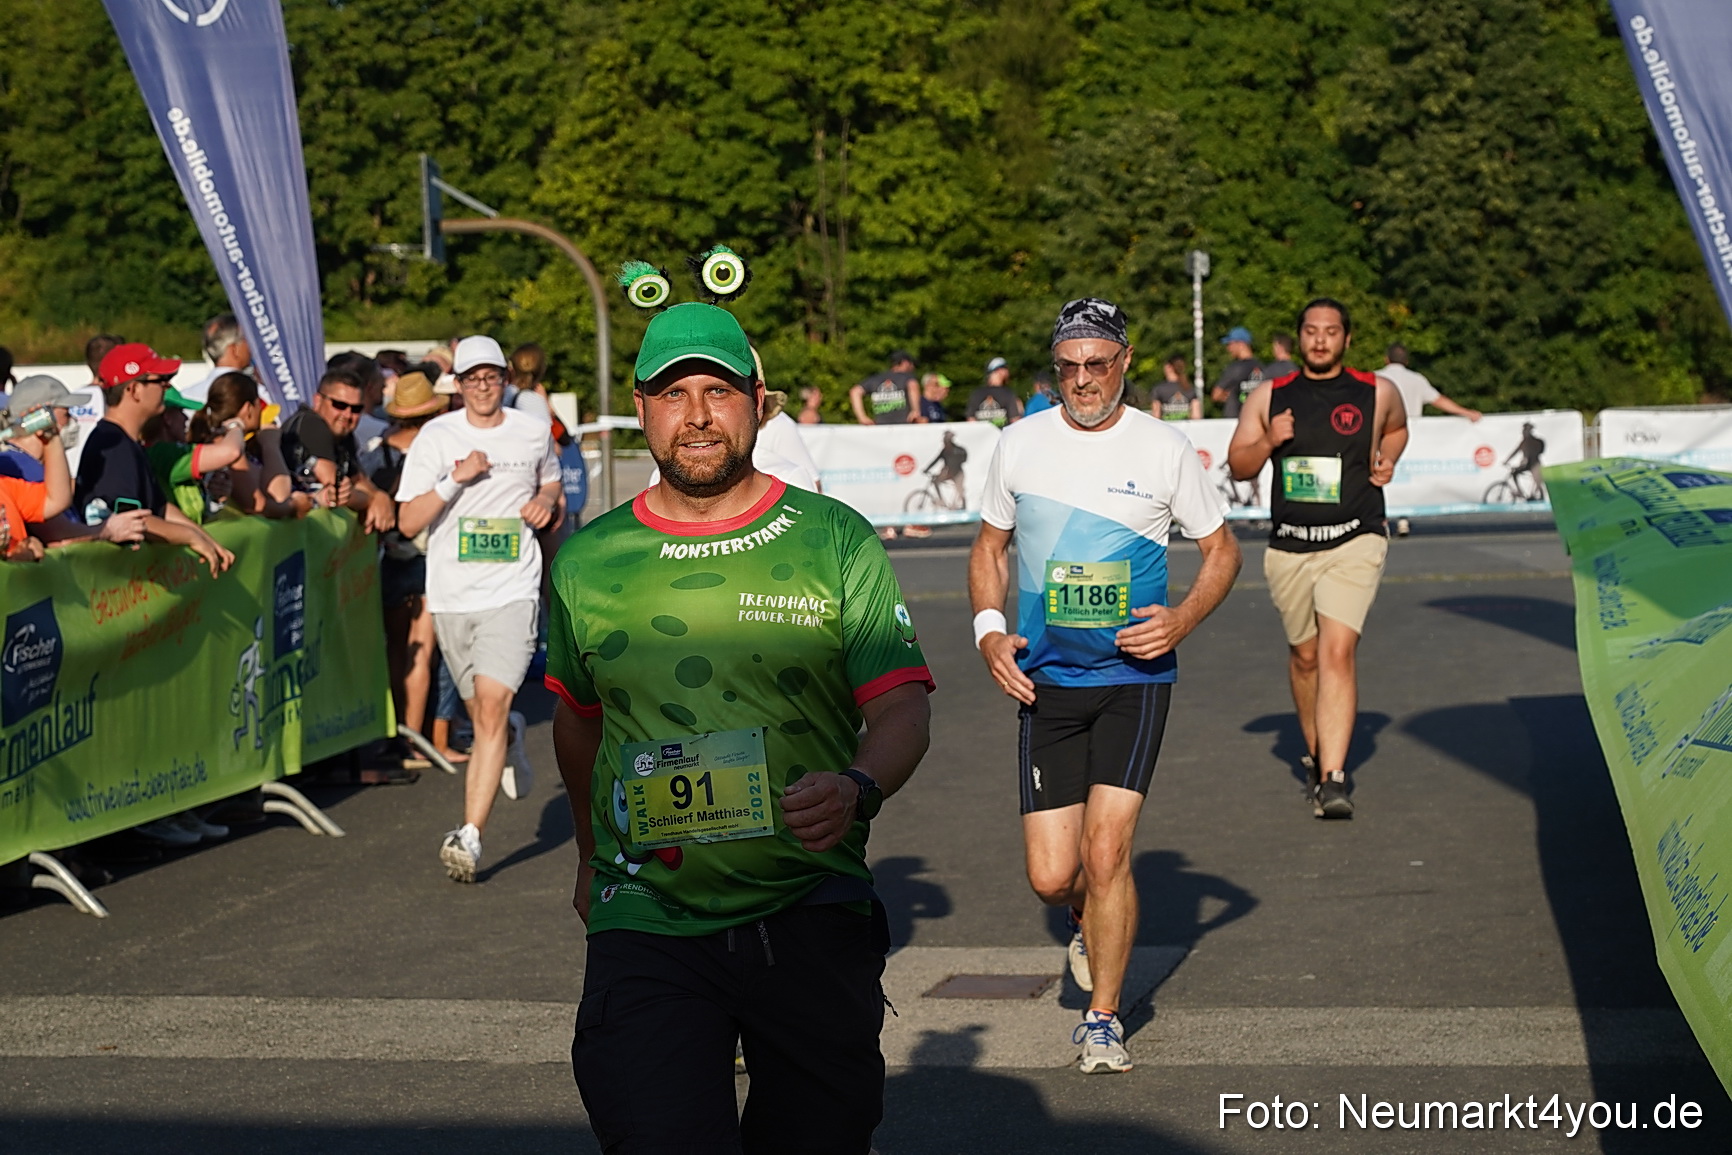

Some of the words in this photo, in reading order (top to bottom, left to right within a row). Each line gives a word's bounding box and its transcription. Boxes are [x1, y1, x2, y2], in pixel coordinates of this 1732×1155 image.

[469, 533, 510, 549] 1361
[659, 513, 797, 559] MONSTERSTARK
[738, 593, 829, 613] TRENDHAUS
[1049, 590, 1058, 613] RUN
[1059, 584, 1118, 606] 1186
[1119, 586, 1127, 616] 2022
[738, 610, 824, 628] POWER-TEAM
[1092, 607, 1114, 616] Peter
[657, 754, 700, 768] Firmenlauf
[673, 761, 700, 770] neumarkt
[670, 771, 715, 810] 91
[748, 771, 765, 821] 2022
[633, 784, 650, 836] WALK
[649, 813, 693, 828] Schlierf
[697, 808, 751, 823] Matthias
